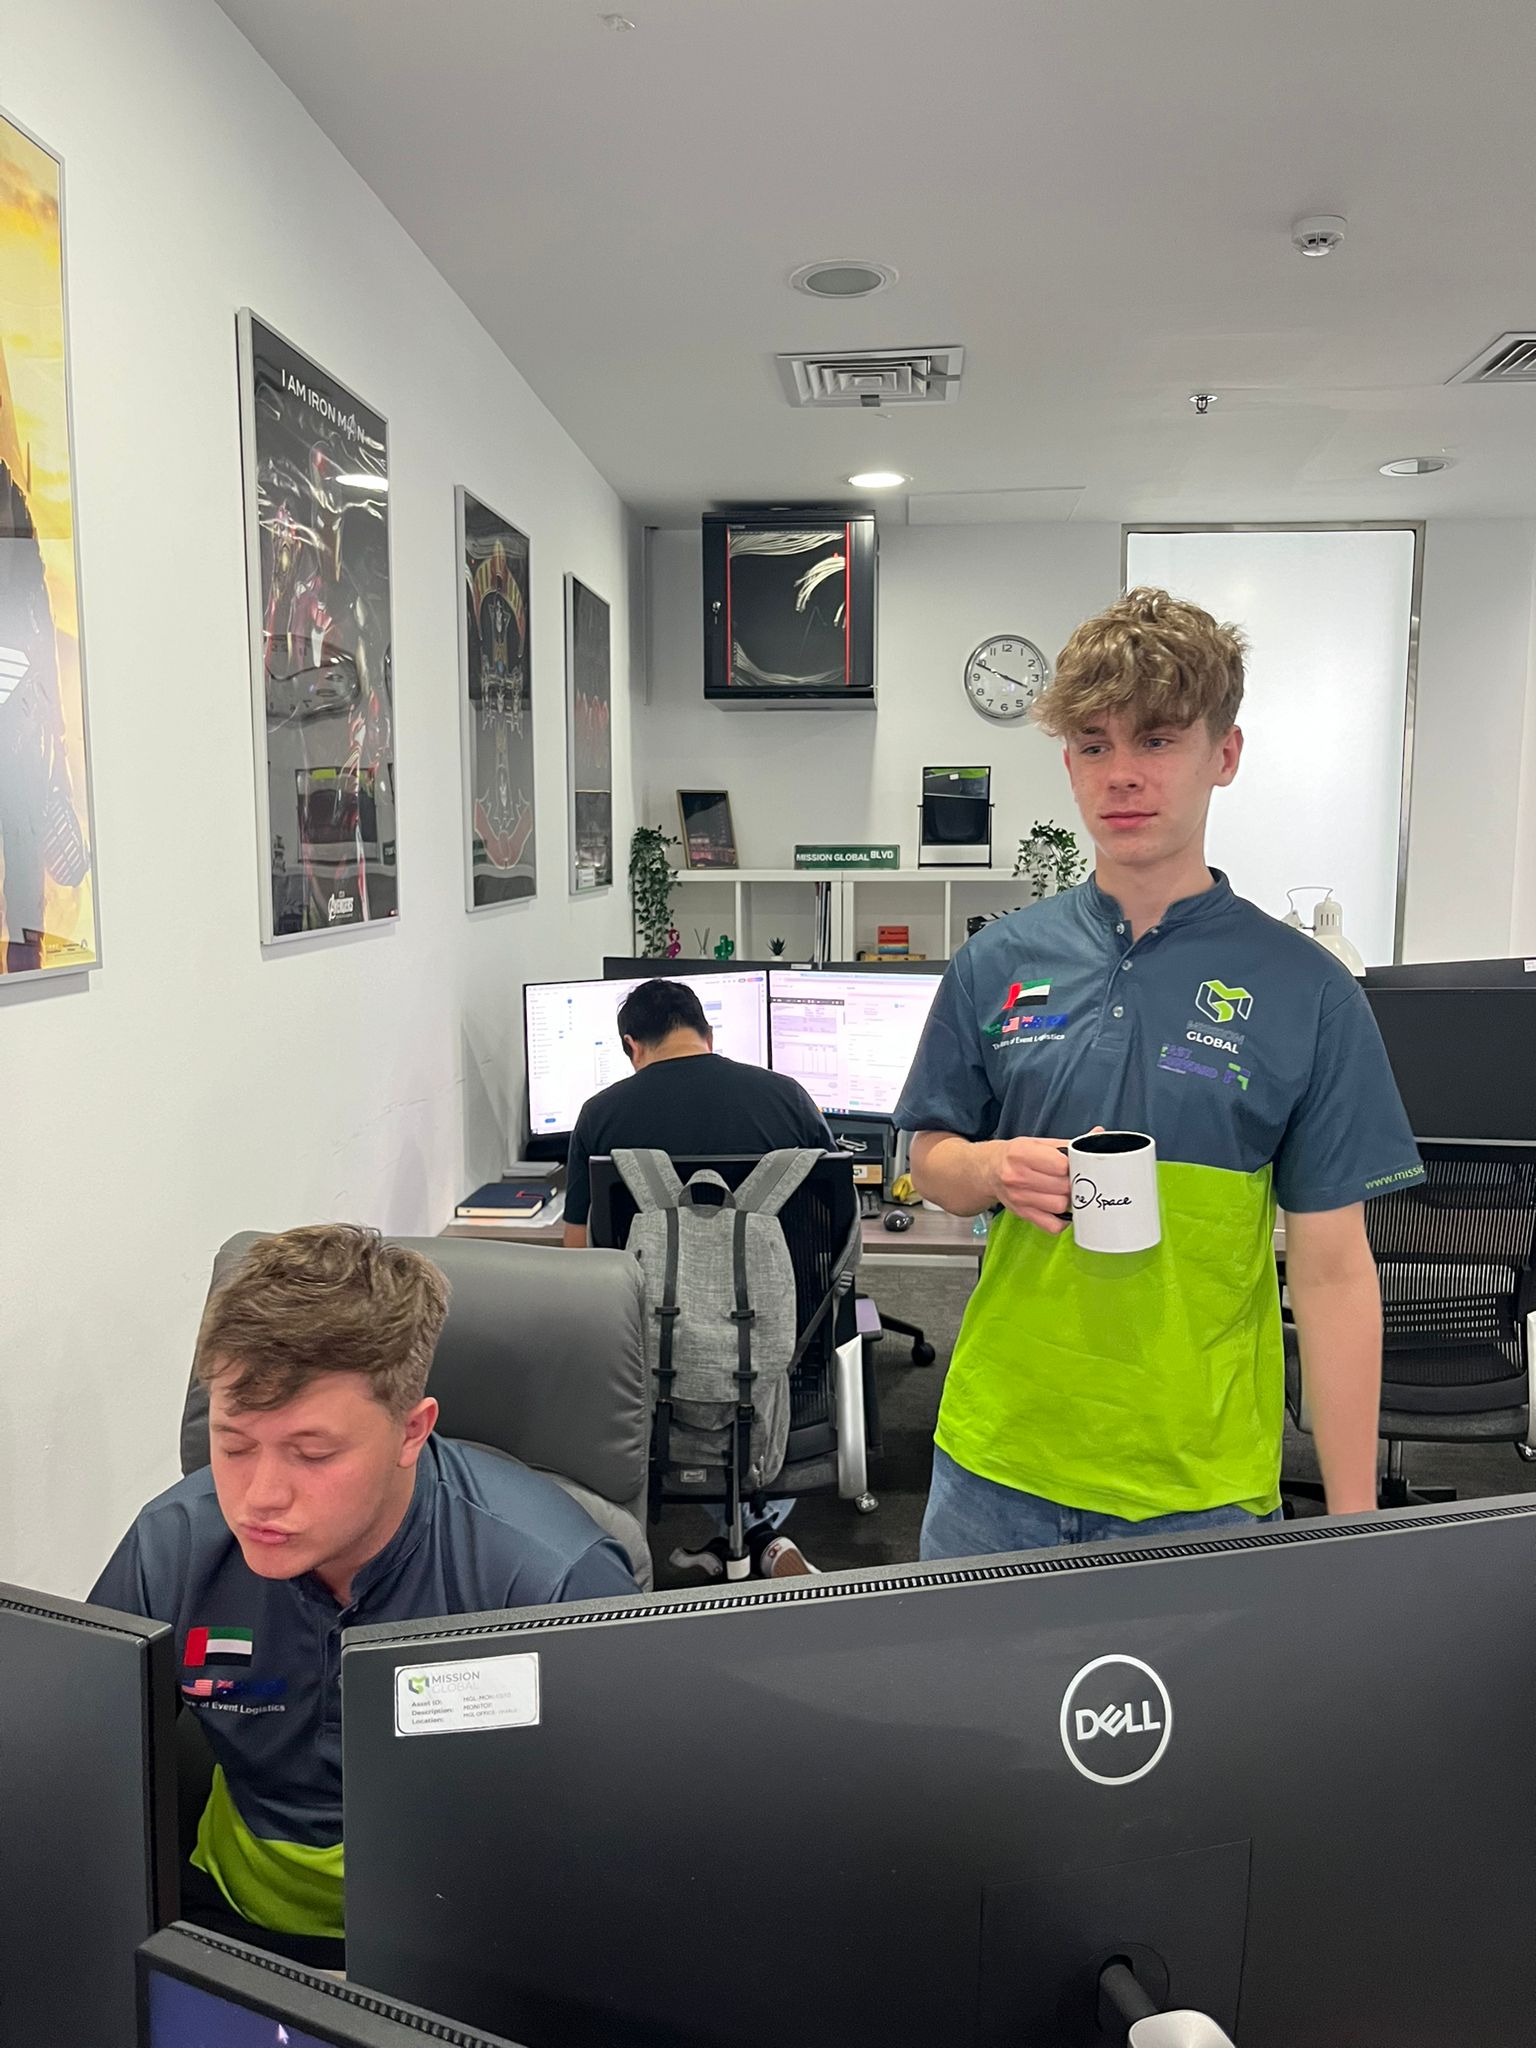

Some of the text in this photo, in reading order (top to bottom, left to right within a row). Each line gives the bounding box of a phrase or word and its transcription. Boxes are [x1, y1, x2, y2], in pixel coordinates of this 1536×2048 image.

[281, 368, 365, 444] I AM IRON MAN
[990, 648, 996, 656] 11
[1002, 644, 1012, 653] 12
[1027, 659, 1036, 667] 2
[972, 673, 981, 681] 9
[1031, 674, 1039, 682] 3
[976, 688, 985, 696] 8
[1026, 689, 1034, 697] 4
[986, 699, 994, 707] 7
[1000, 703, 1008, 712] 6
[1015, 699, 1024, 708] 5
[795, 850, 894, 862] MISSION GLOBAL BLVD
[1186, 1030, 1240, 1055] GLOBAL
[1096, 1193, 1132, 1211] Space
[431, 1671, 480, 1684] MISSION
[431, 1682, 479, 1694] GLOBAL
[211, 1701, 238, 1712] Event
[240, 1704, 286, 1715] Logistics
[411, 1707, 453, 1716] Description:
[411, 1717, 444, 1725] Location:
[1075, 1700, 1161, 1740] DELL
